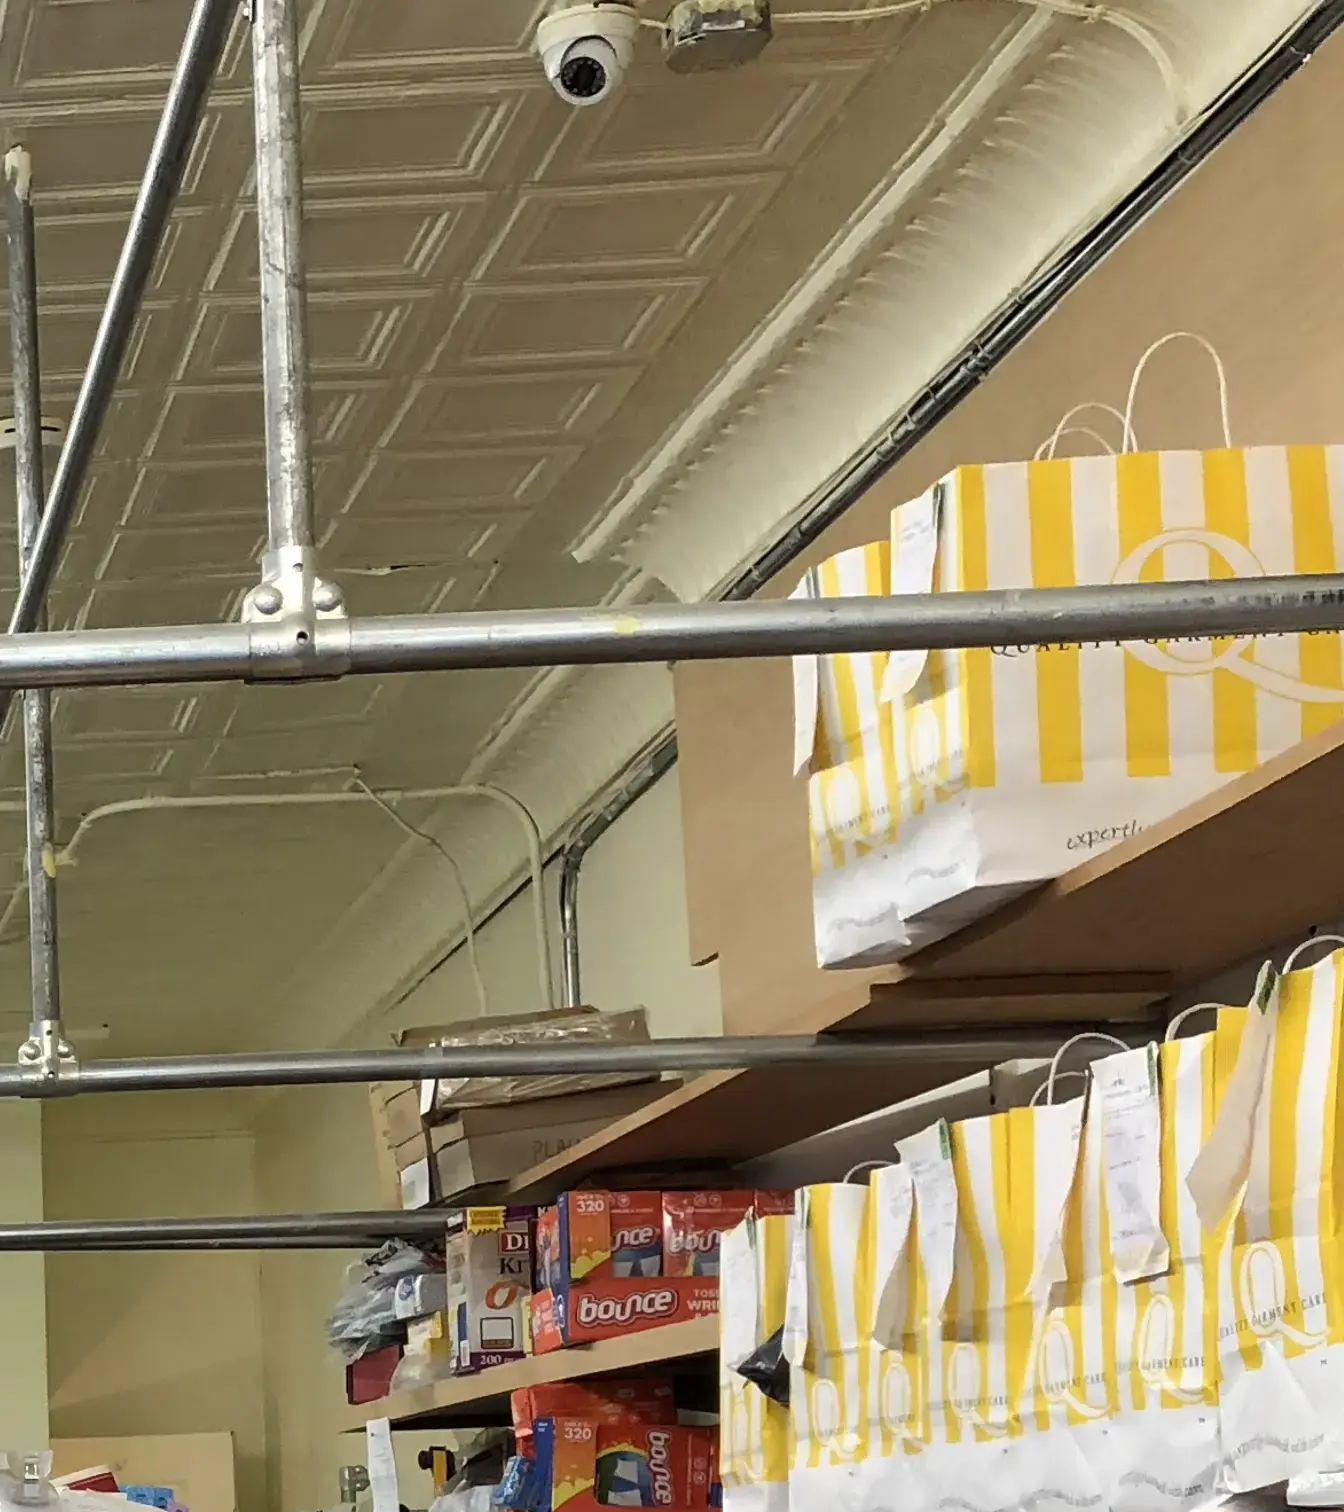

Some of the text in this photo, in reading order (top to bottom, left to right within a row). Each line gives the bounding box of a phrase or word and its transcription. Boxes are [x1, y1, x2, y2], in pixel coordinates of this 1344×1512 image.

[576, 1200, 605, 1213] 320
[578, 1289, 674, 1325] bounce
[479, 1354, 502, 1365] 200
[564, 1428, 593, 1440] 320
[648, 1430, 672, 1505] bounce
